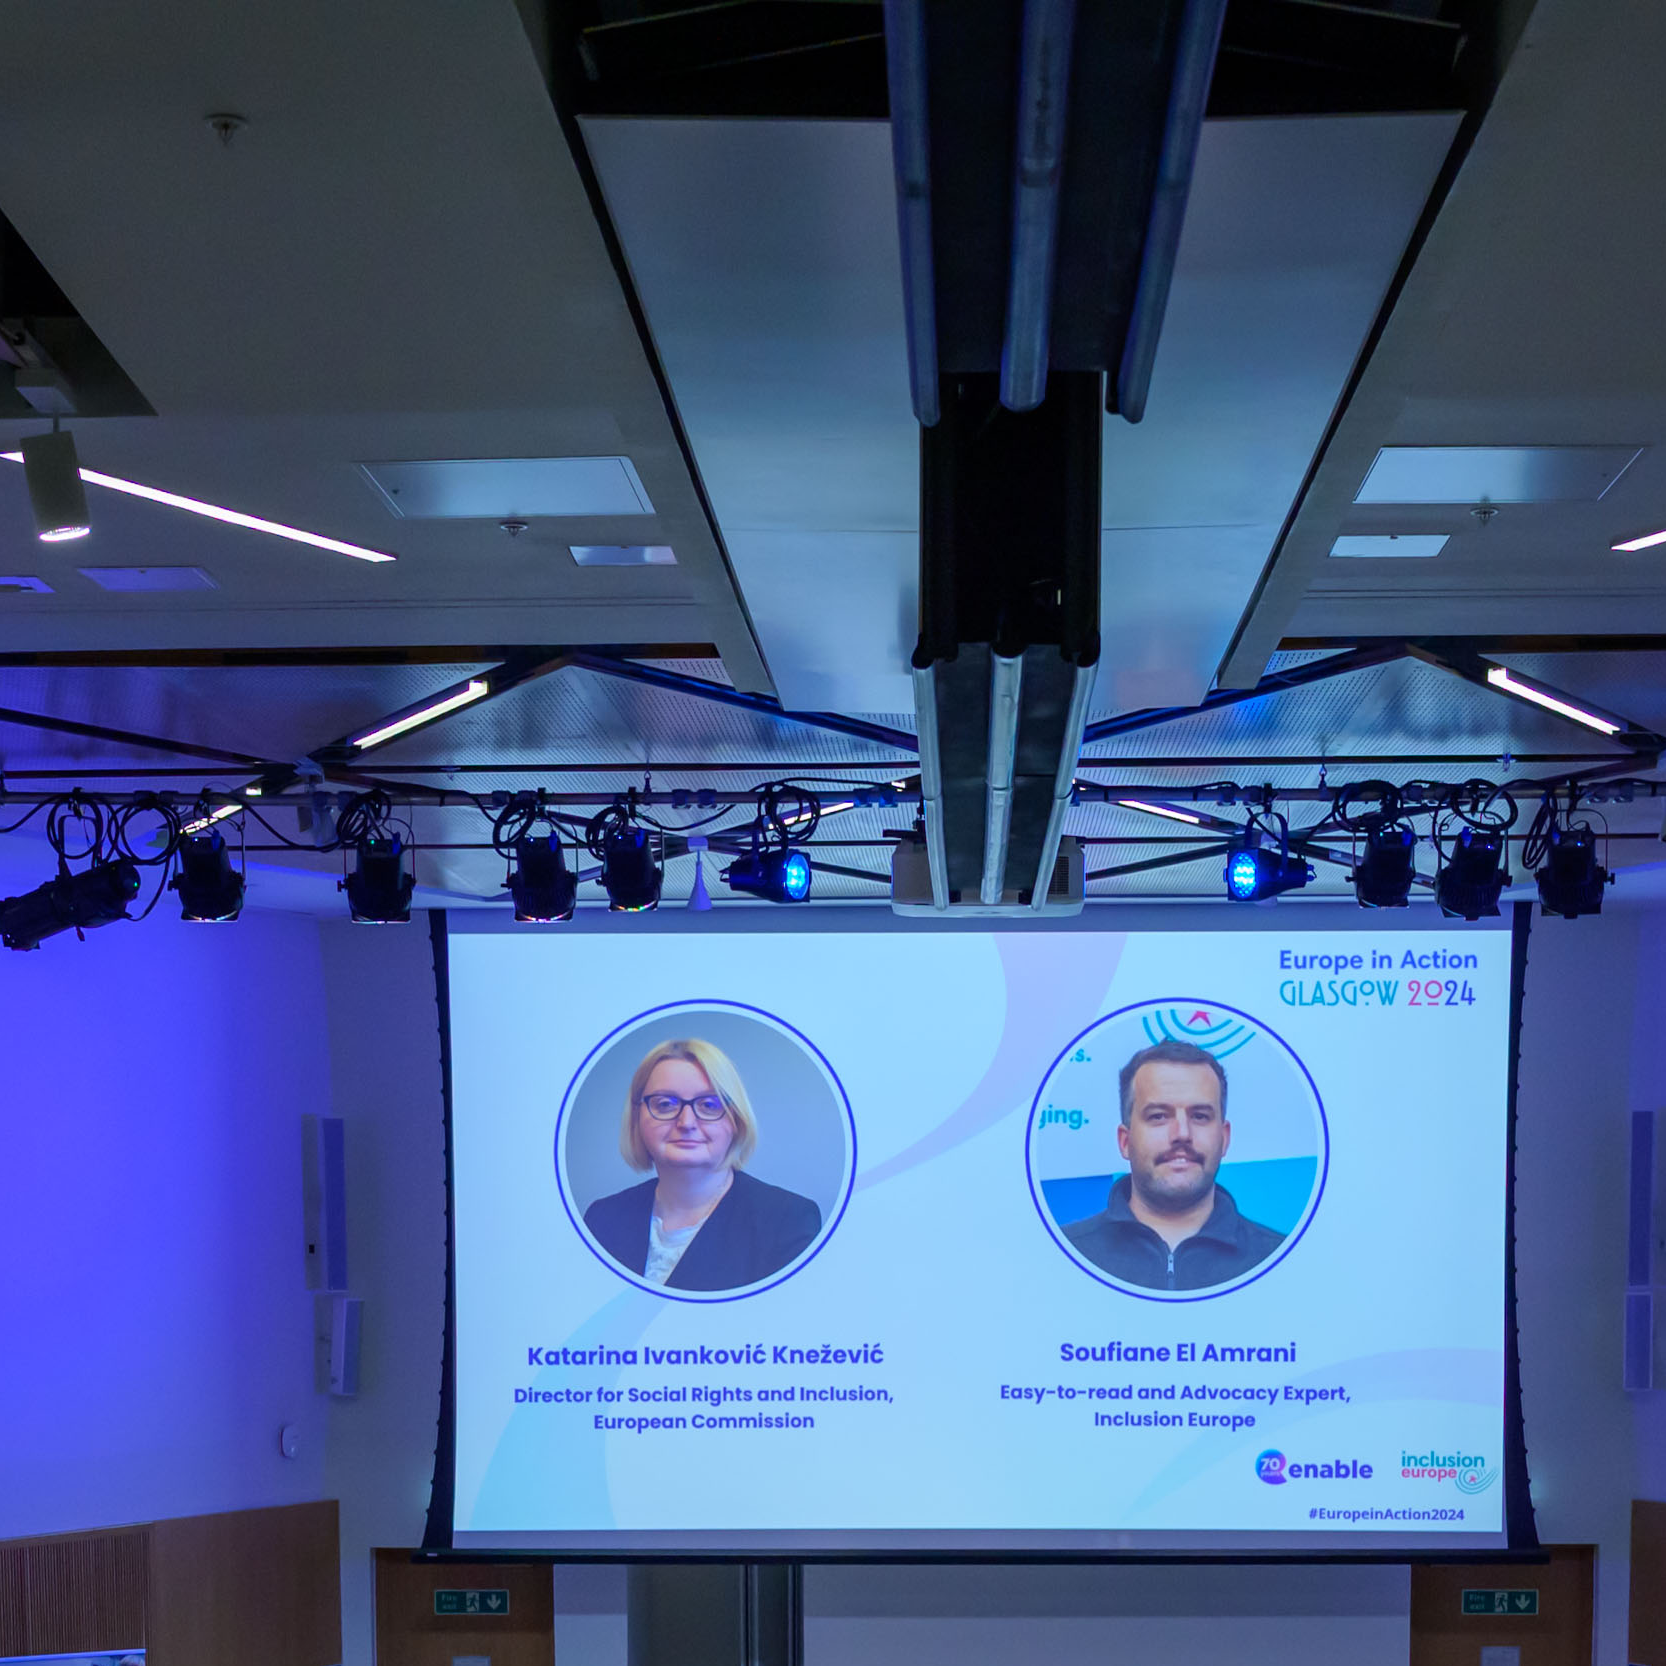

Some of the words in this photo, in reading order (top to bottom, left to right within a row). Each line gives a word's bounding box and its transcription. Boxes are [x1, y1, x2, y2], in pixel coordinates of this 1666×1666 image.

[1280, 949, 1364, 975] Europe
[1372, 949, 1392, 969] in
[1400, 948, 1478, 969] Action
[1279, 979, 1399, 1007] GLASGOW
[1407, 979, 1476, 1007] 2024
[528, 1344, 638, 1366] Katarina
[644, 1343, 767, 1365] Ivanković
[773, 1343, 884, 1364] Knežević
[1060, 1341, 1171, 1362] Soufiane
[1176, 1342, 1196, 1362] El
[1201, 1341, 1297, 1362] Amrani
[514, 1386, 593, 1403] Director
[597, 1386, 624, 1403] for
[628, 1386, 687, 1402] Social
[691, 1385, 753, 1406] Rights
[757, 1386, 795, 1402] and
[800, 1385, 894, 1403] Inclusion,
[1000, 1384, 1133, 1404] Easy-to-read
[1137, 1384, 1176, 1400] and
[1180, 1384, 1280, 1405] Advocacy
[1283, 1385, 1351, 1405] Expert,
[594, 1414, 687, 1434] European
[691, 1412, 815, 1429] Commission
[1095, 1410, 1183, 1427] Inclusion
[1188, 1412, 1256, 1432] Europe
[1288, 1459, 1374, 1479] enable
[1401, 1450, 1485, 1467] inclusion
[1401, 1468, 1457, 1482] europe
[1309, 1507, 1465, 1523] #EuropeinAction2024
